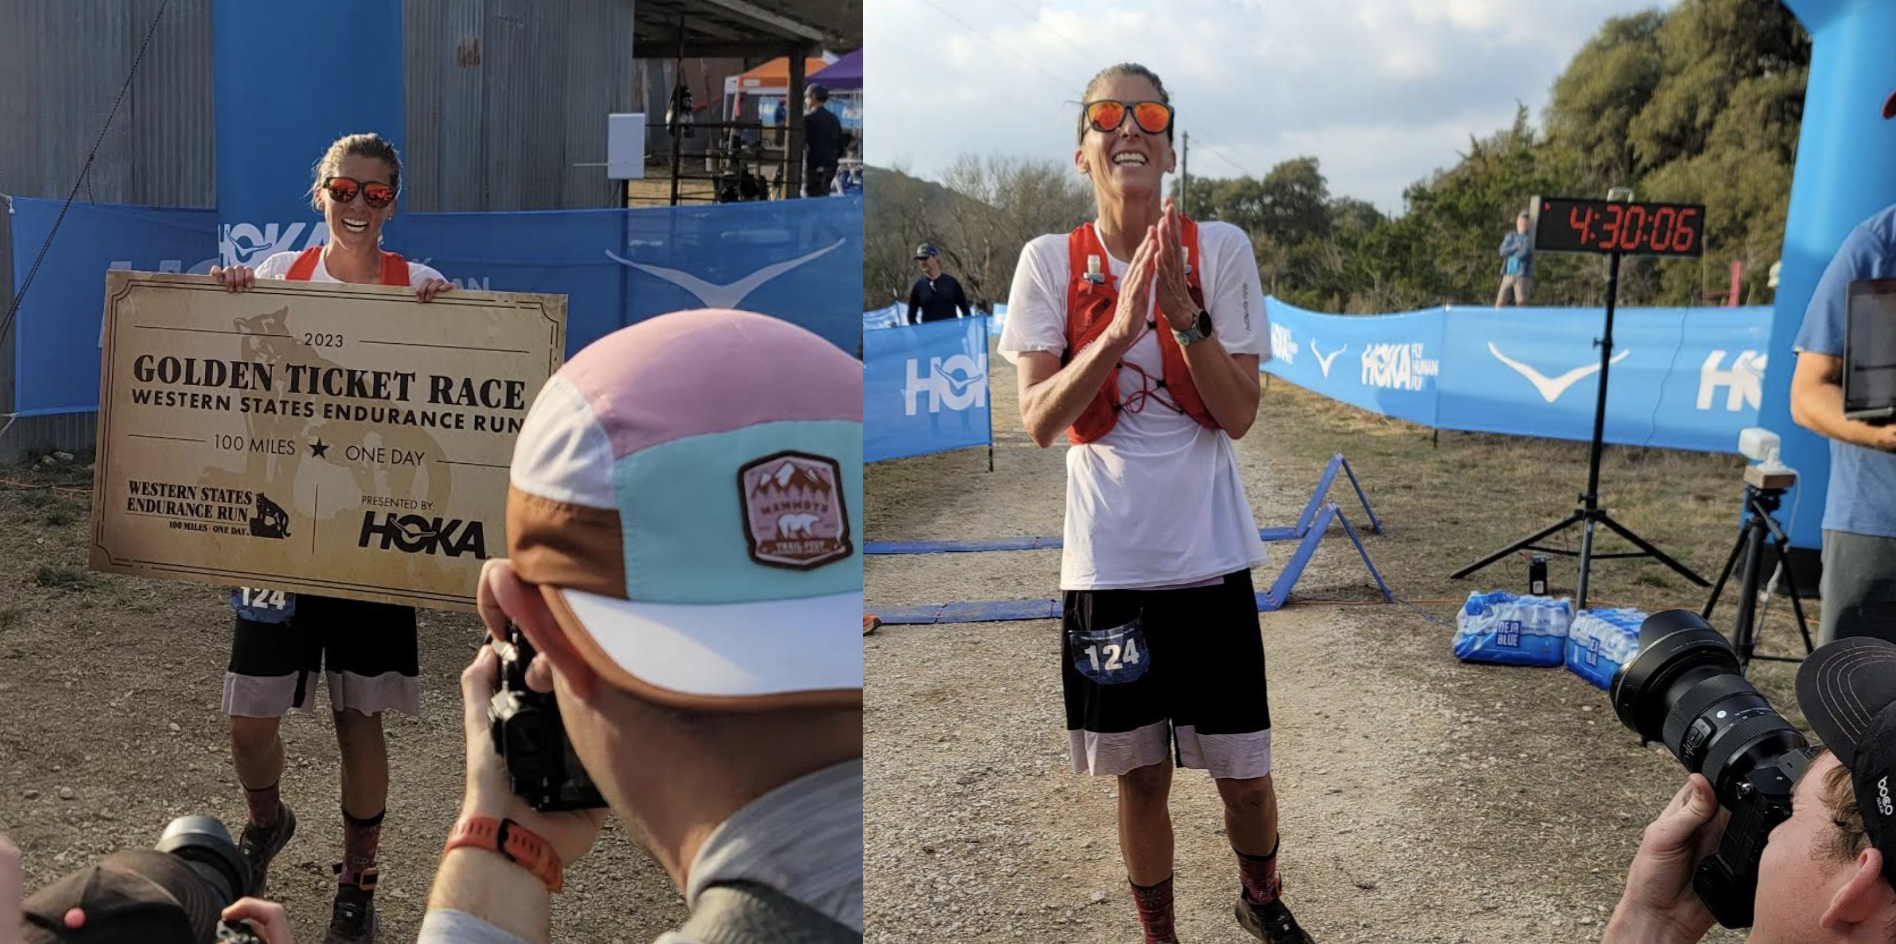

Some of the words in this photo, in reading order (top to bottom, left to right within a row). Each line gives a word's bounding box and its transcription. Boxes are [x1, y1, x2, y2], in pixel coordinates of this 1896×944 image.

[1570, 204, 1697, 251] 4:30:06
[304, 333, 344, 348] 2023
[1361, 343, 1411, 391] HOKA
[133, 354, 275, 391] GOLDEN
[285, 362, 416, 402] TICKET
[427, 375, 526, 410] RACE
[131, 388, 231, 411] WESTERN
[240, 396, 315, 418] STATES
[323, 403, 465, 430] ENDURANCE
[474, 415, 525, 434] RUN
[214, 434, 244, 451] 100
[249, 438, 296, 456] MILES
[345, 445, 386, 464] ONE
[391, 449, 425, 466] DAY
[128, 480, 197, 500] WESTERN
[200, 486, 253, 506] STATES
[361, 495, 418, 510] PRESENTED
[421, 501, 436, 512] BY:
[126, 497, 213, 519] ENDURANCE
[217, 504, 248, 523] RUN
[169, 521, 182, 530] 100
[183, 523, 208, 532] MILES
[212, 525, 229, 534] ONE
[358, 510, 486, 560] HOKA
[240, 586, 286, 611] 124
[1497, 633, 1519, 647] BLUE
[1498, 621, 1519, 634] DEJA
[1083, 638, 1140, 671] 124
